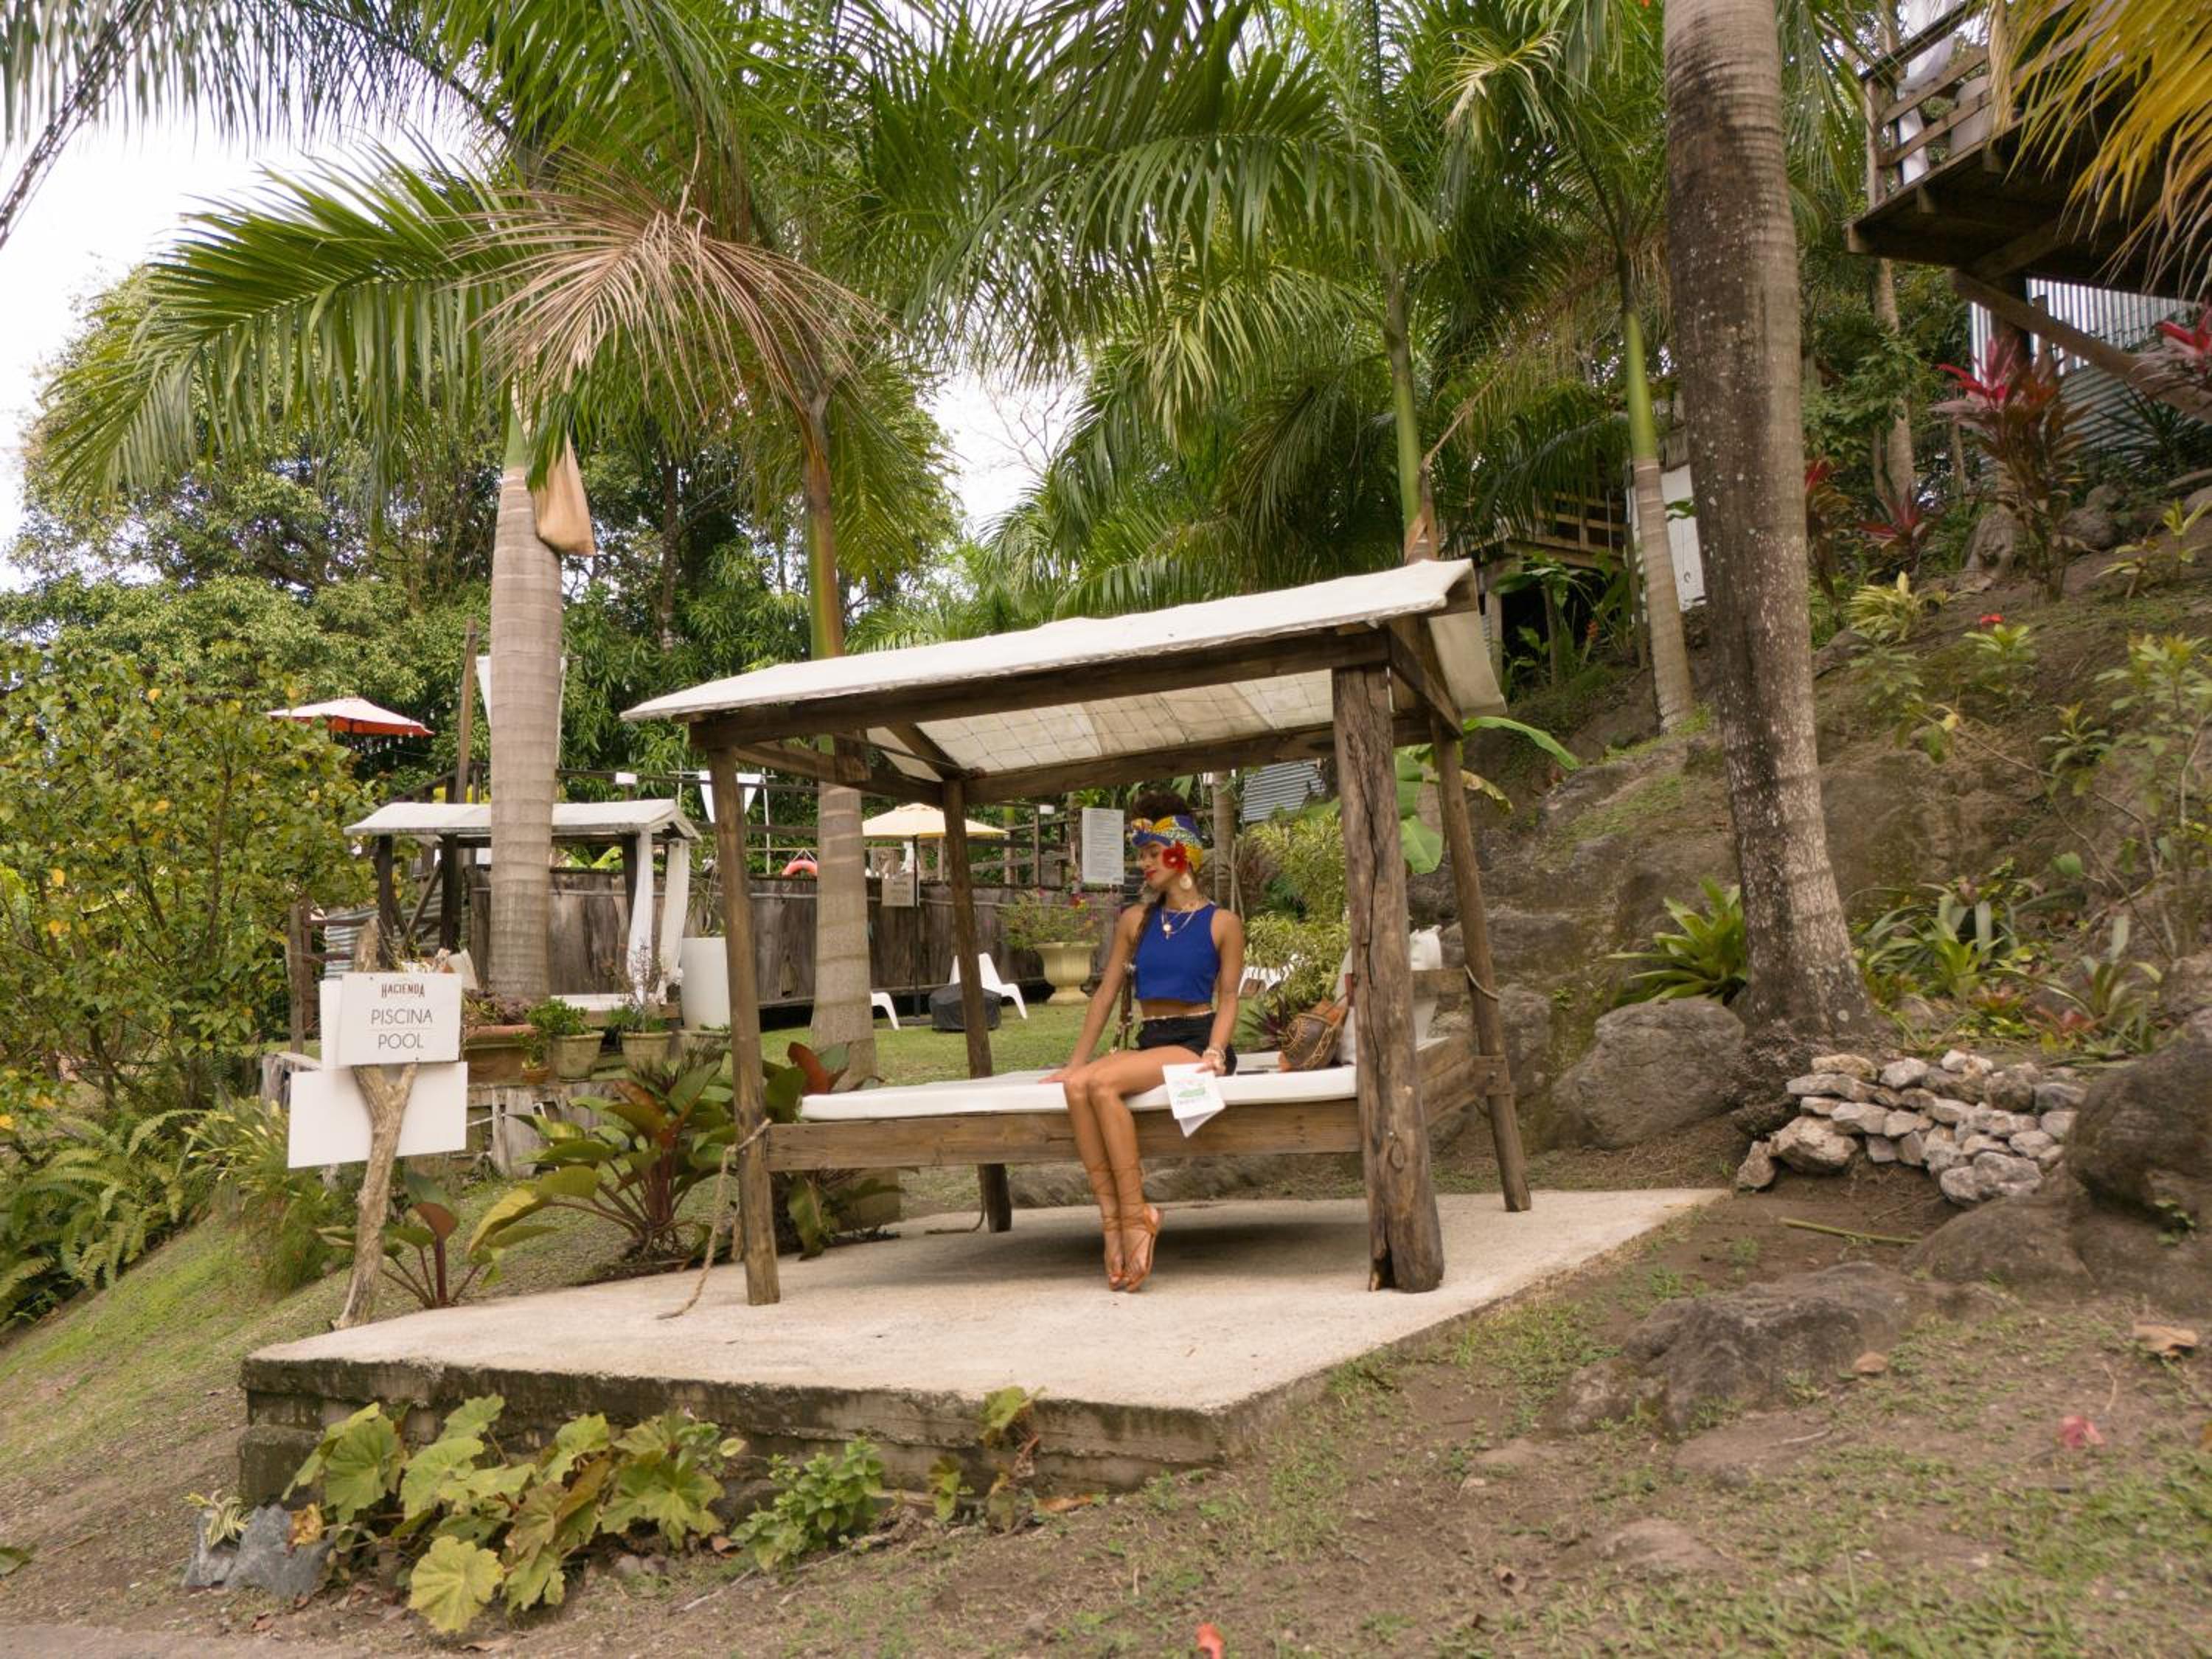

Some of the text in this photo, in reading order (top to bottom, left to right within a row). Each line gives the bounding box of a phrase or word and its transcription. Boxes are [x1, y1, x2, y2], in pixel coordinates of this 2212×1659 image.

[381, 983, 425, 998] HACIENDA
[371, 1008, 433, 1024] PISCINA
[378, 1033, 424, 1049] POOL
